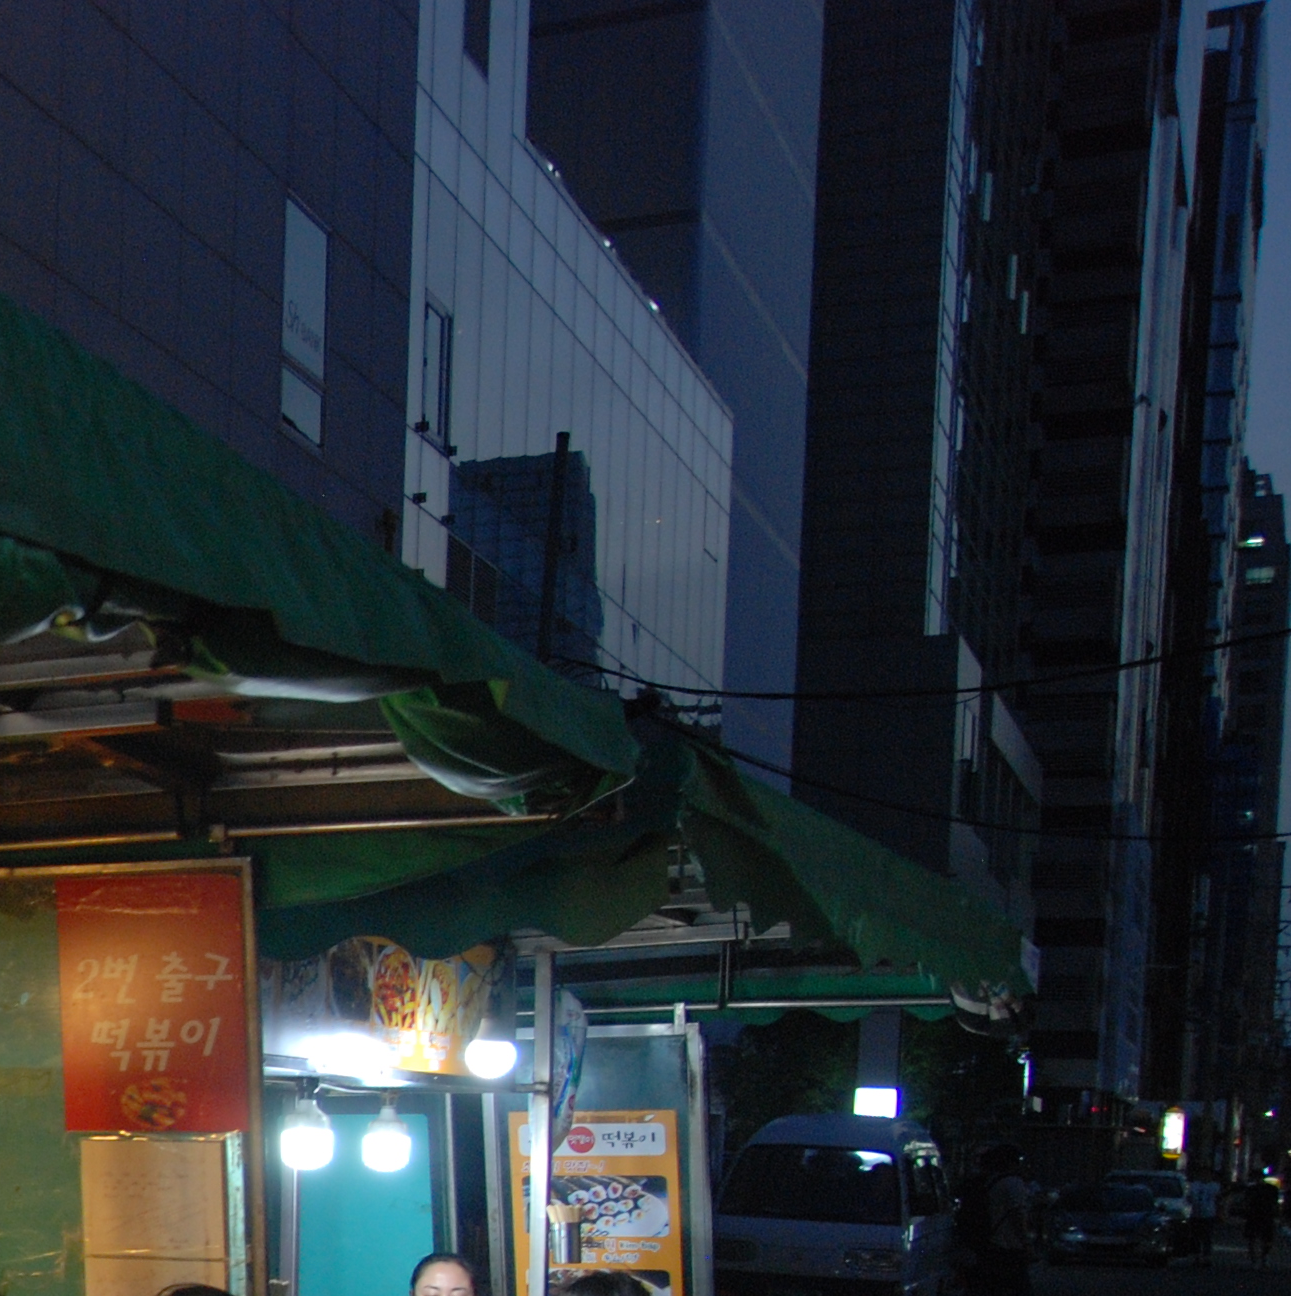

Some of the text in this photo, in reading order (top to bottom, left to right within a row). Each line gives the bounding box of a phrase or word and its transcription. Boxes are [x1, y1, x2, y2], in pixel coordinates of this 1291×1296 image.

[71, 951, 234, 1005] 2번 출구
[90, 1016, 221, 1072] 떡볶이
[601, 1130, 656, 1149] 떡볶이
